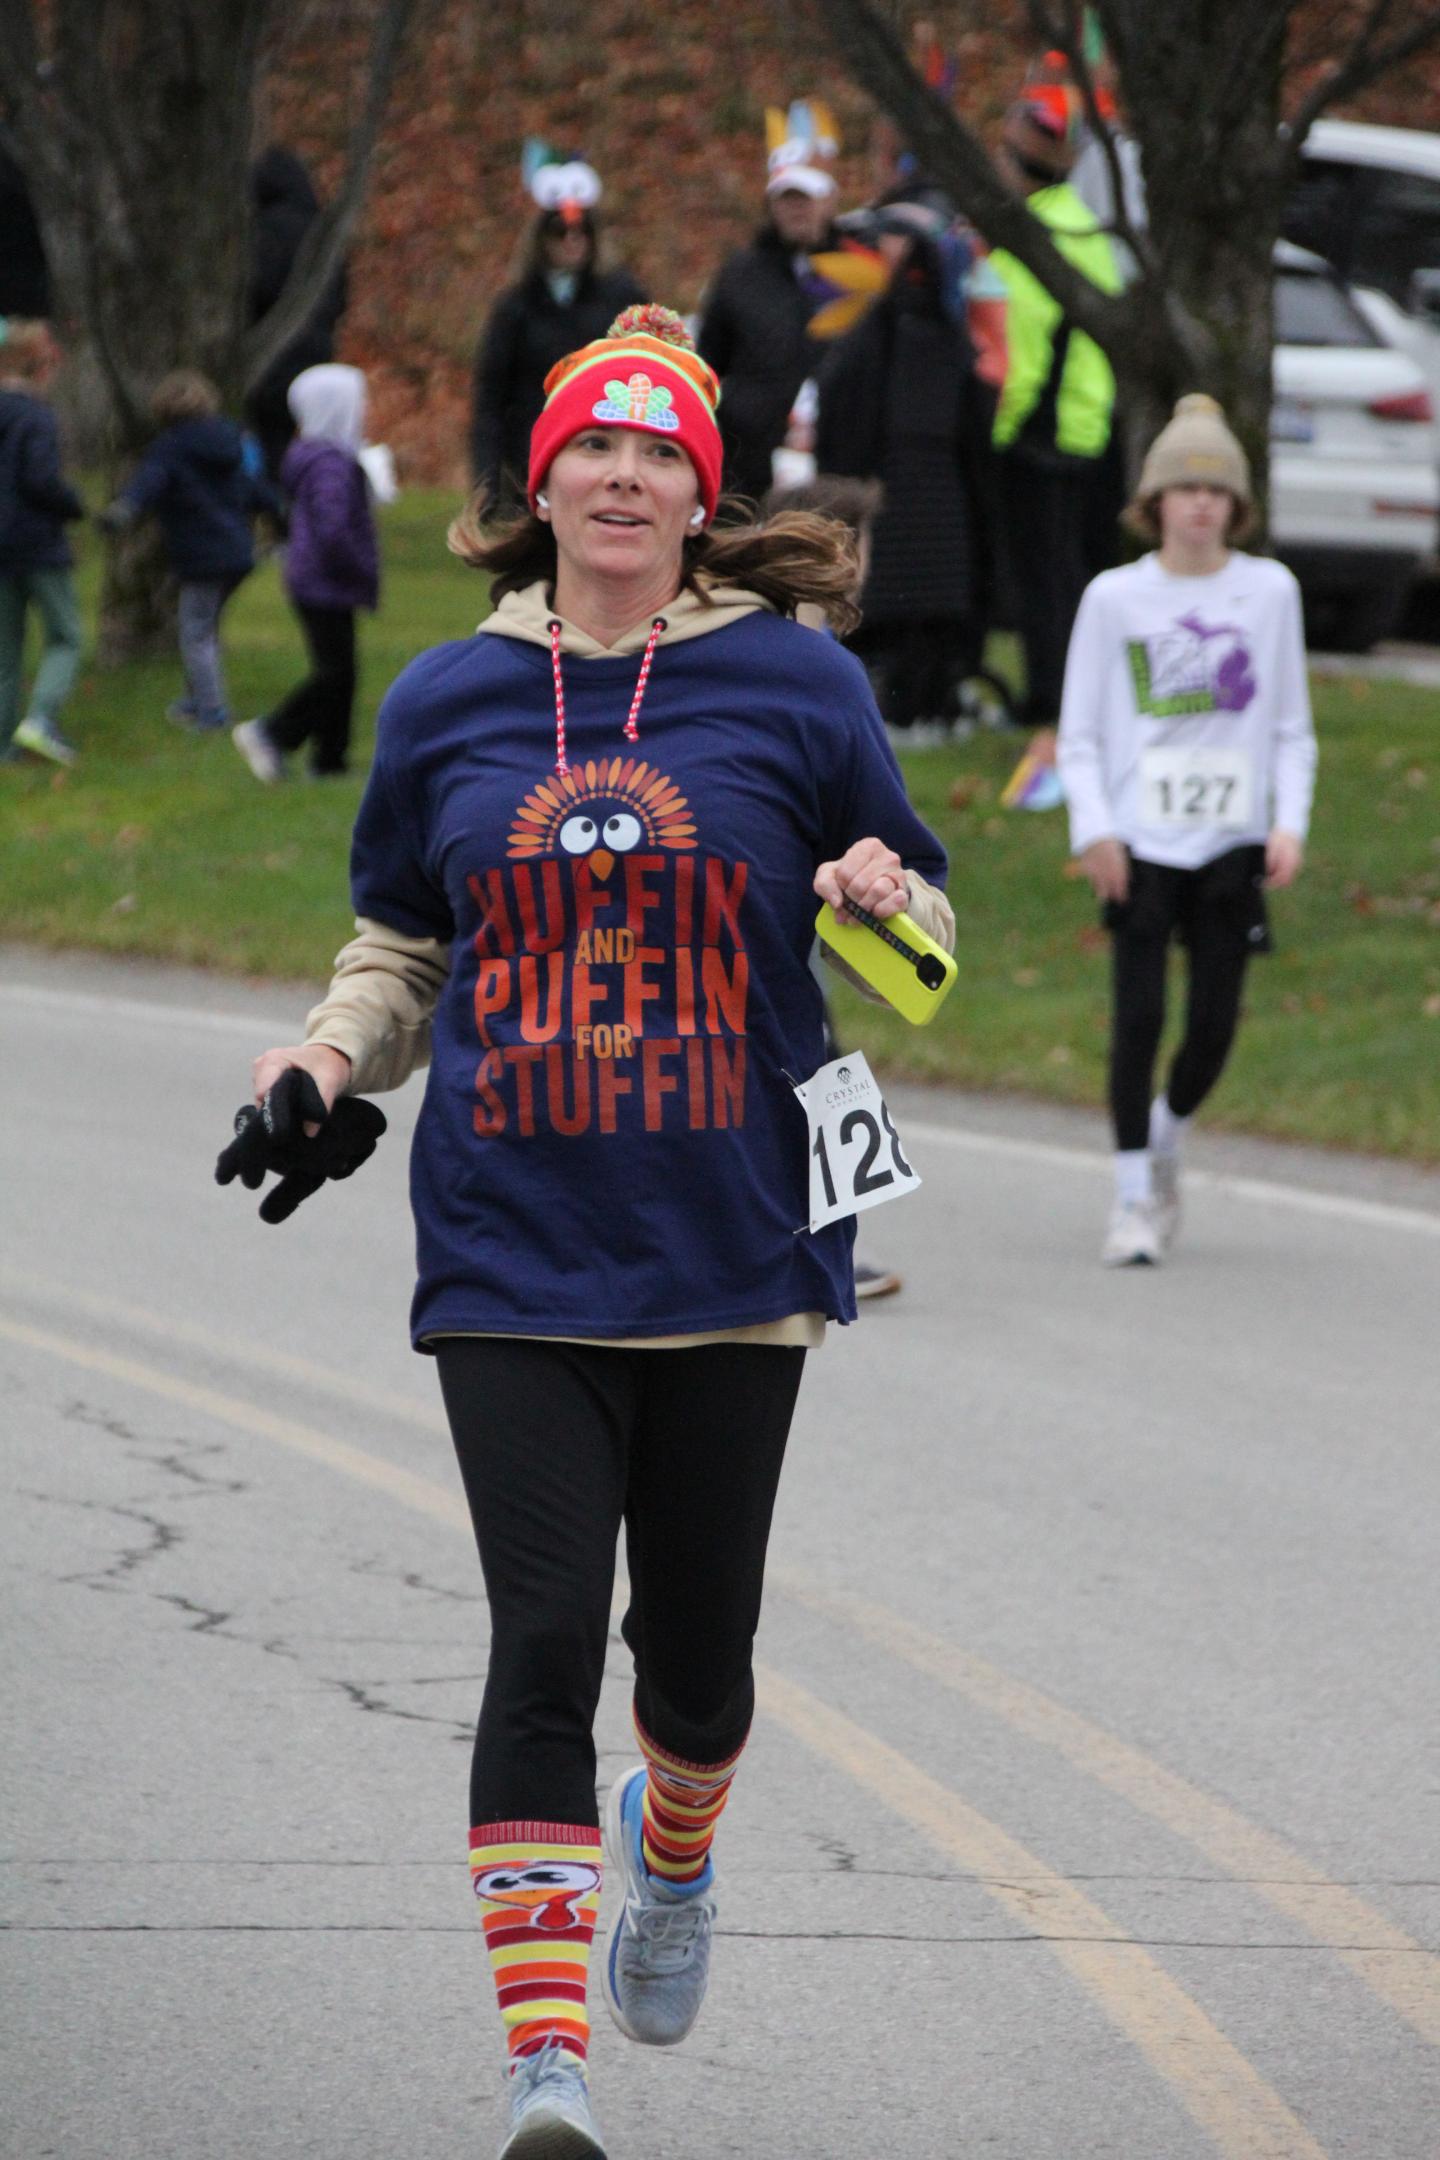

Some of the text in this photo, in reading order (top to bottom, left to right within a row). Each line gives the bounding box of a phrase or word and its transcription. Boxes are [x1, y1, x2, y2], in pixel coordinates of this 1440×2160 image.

[1157, 777, 1236, 814] 127
[467, 854, 748, 956] HUFFIN
[574, 927, 636, 965] AND
[474, 946, 749, 1047] PUFFIN
[576, 1023, 633, 1060] FOR
[473, 1037, 747, 1137] STUFFIN
[825, 1079, 870, 1104] CRYSTAL
